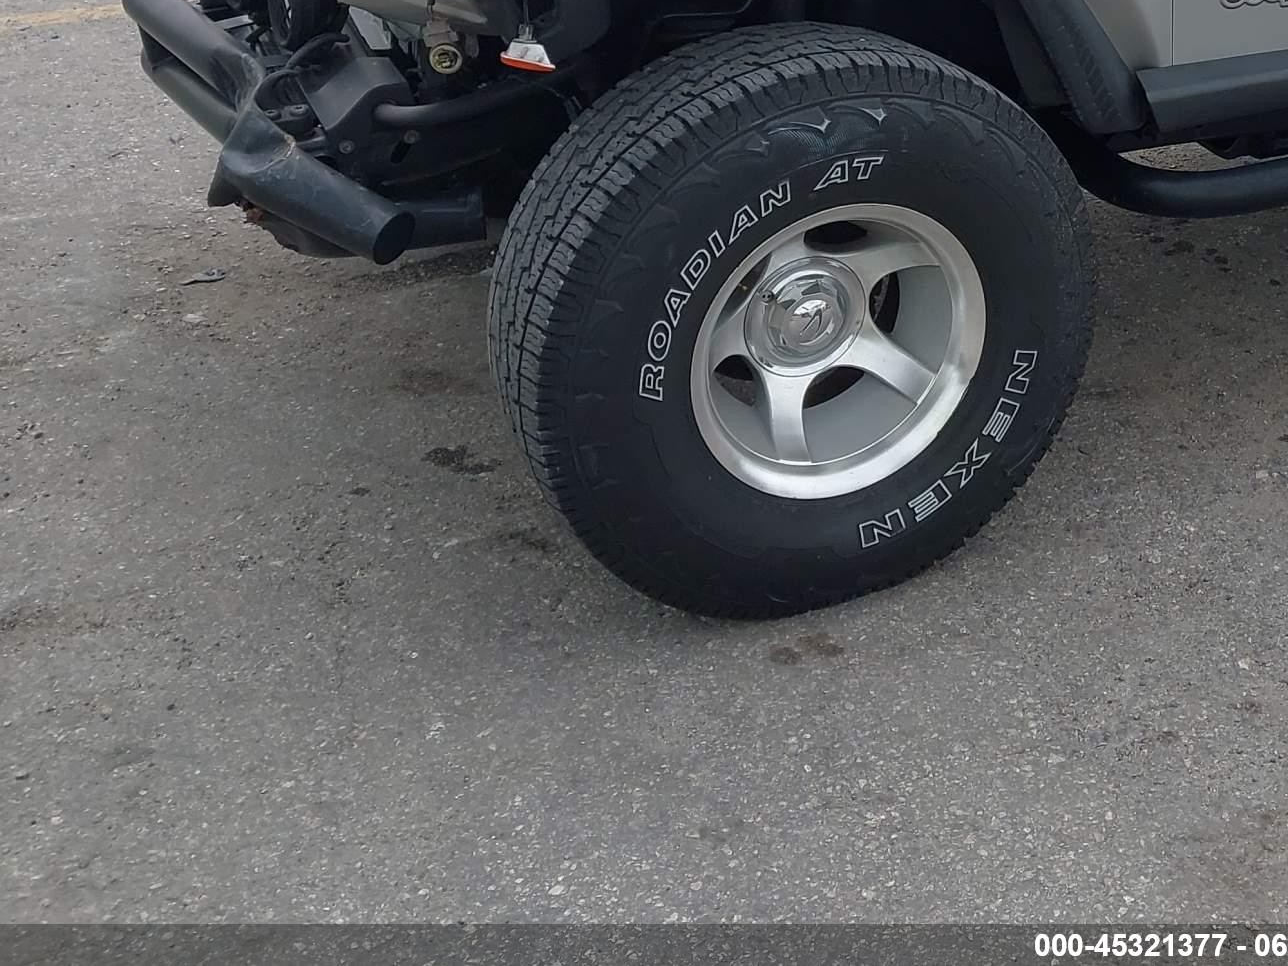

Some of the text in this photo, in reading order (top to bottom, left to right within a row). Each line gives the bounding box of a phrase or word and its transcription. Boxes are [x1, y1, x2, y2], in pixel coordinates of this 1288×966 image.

[639, 156, 884, 401] ROADIAN AT
[858, 349, 1038, 548] NEXEN
